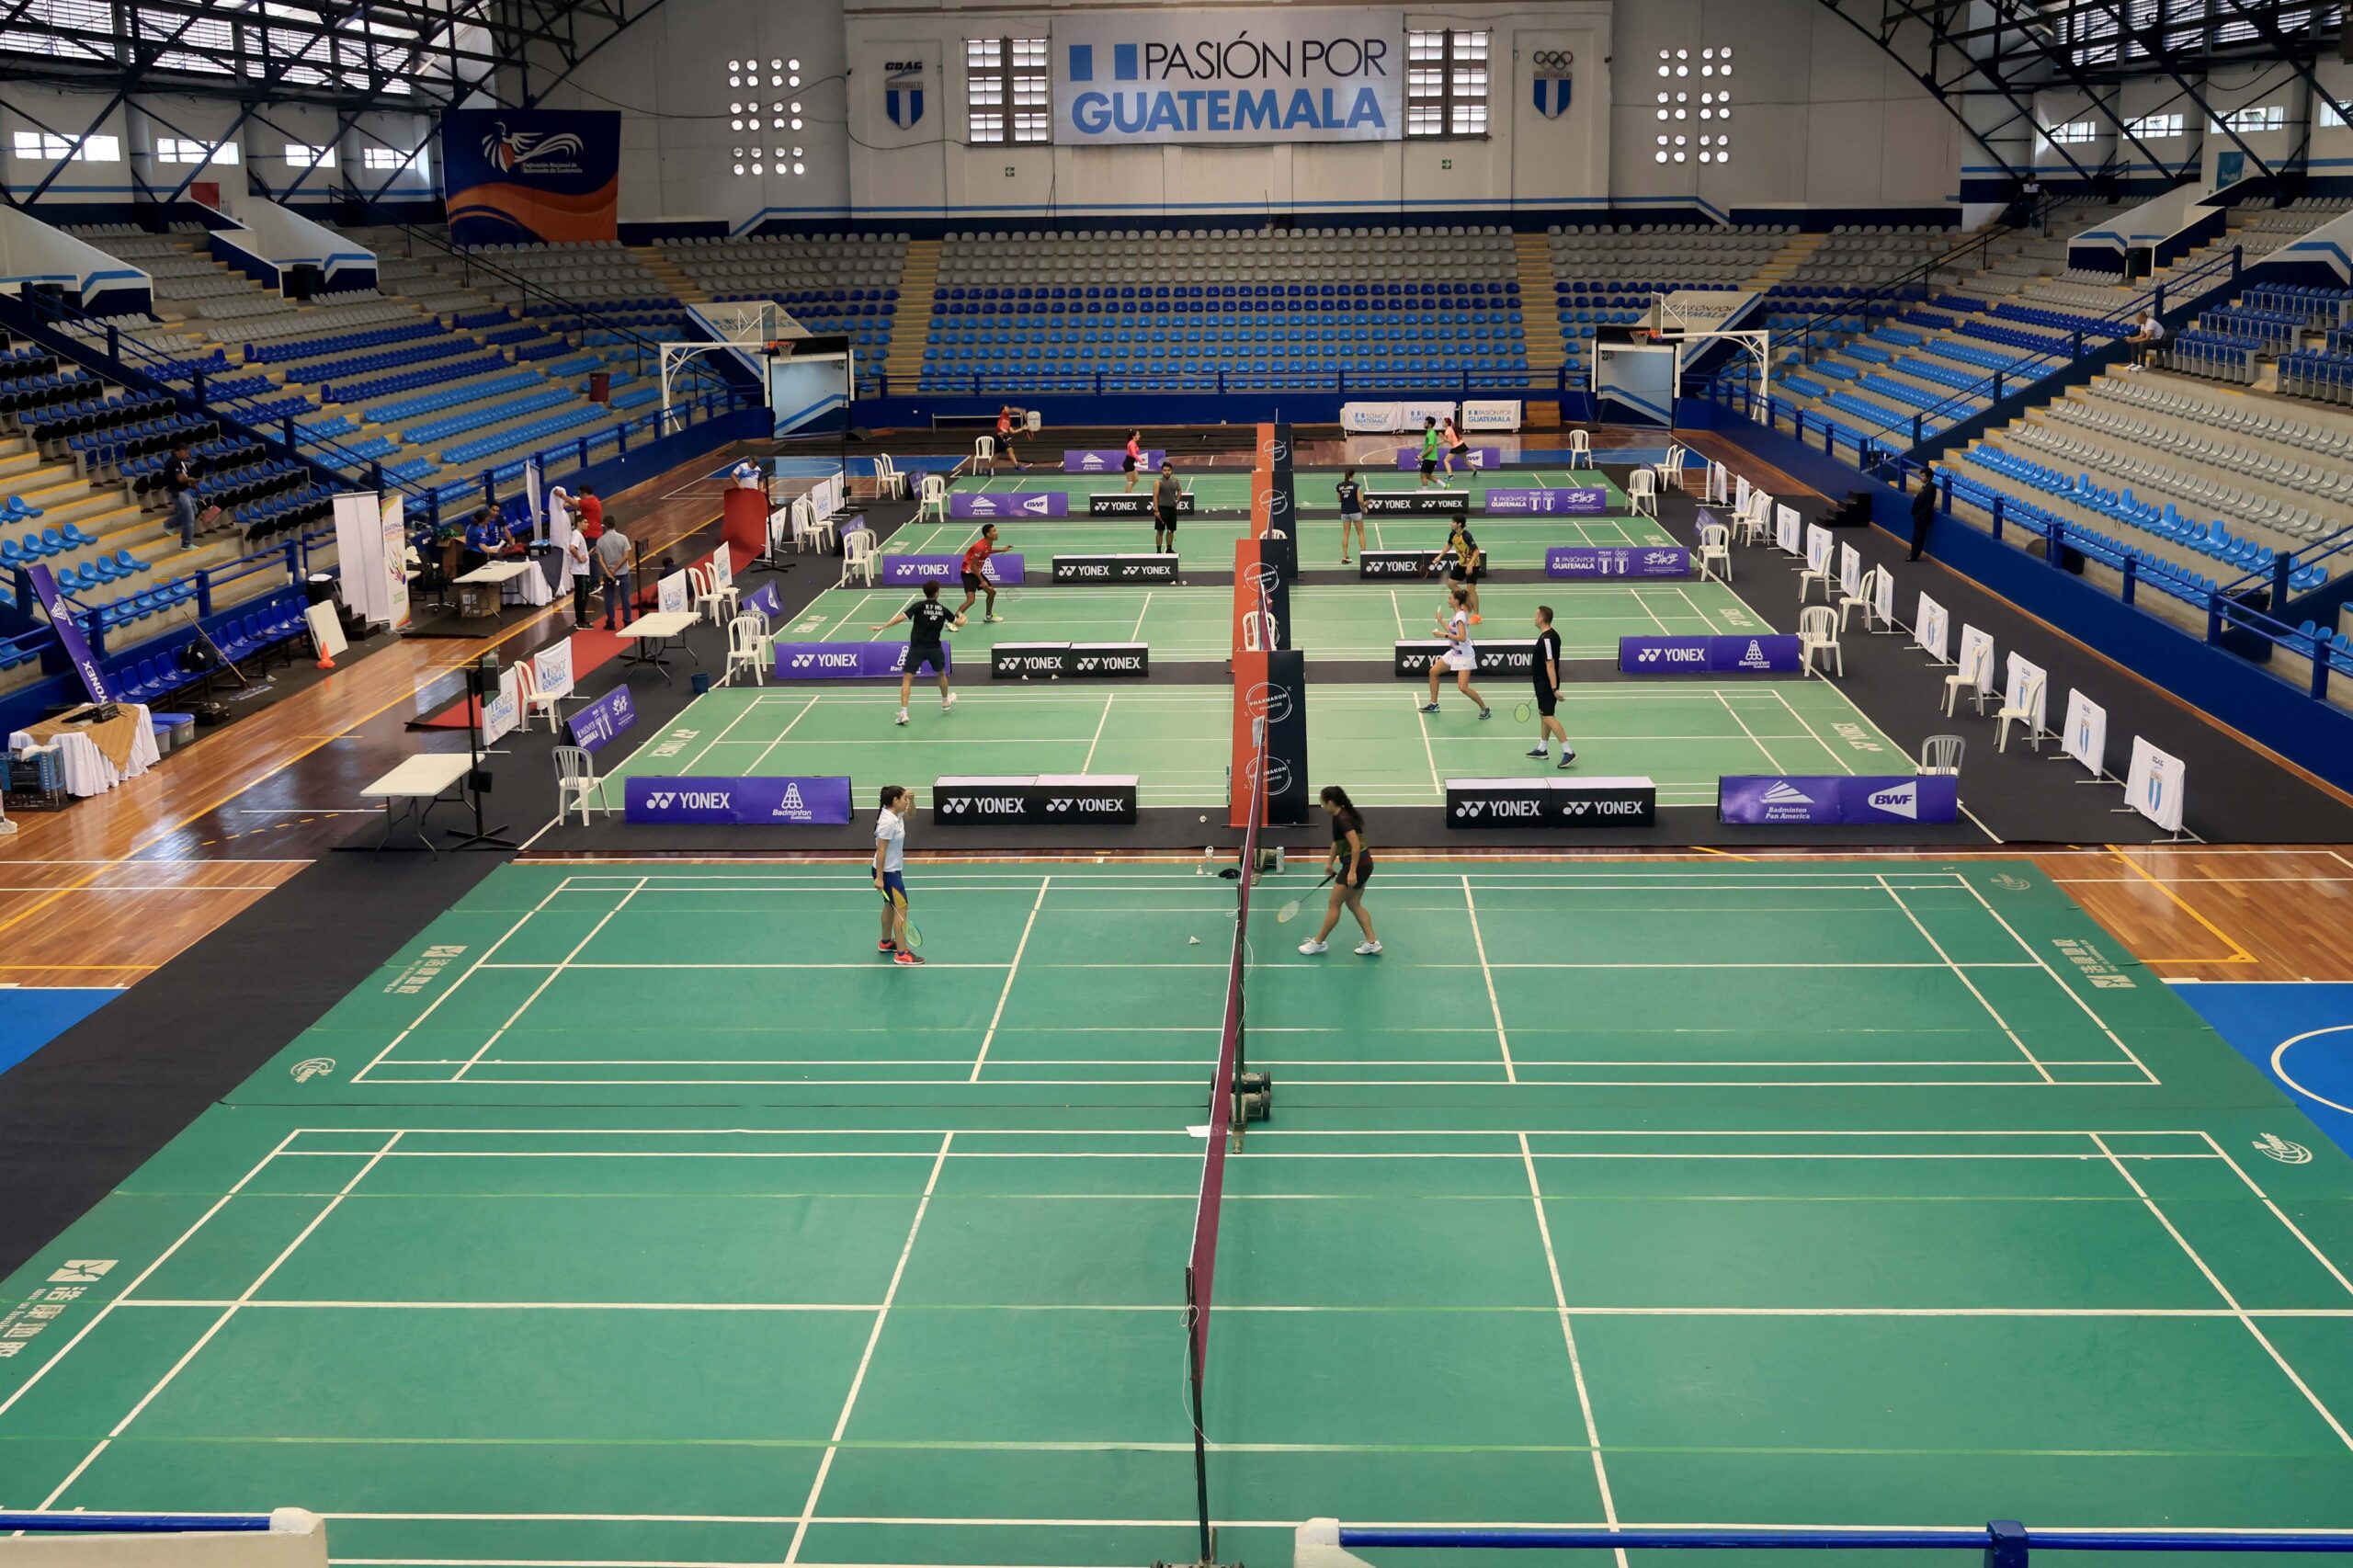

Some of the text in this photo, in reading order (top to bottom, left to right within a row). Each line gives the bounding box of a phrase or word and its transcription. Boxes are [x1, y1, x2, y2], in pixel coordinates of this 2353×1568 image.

[1145, 30, 1387, 80] PASIÓN POR
[1072, 87, 1386, 134] GUATEMALA
[1111, 502, 1137, 511] YONEX
[1384, 500, 1411, 509] YONEX
[1438, 500, 1462, 508] YONEX
[917, 564, 949, 575] YONEX
[1078, 565, 1110, 576] YONEX
[1141, 566, 1172, 575] YONEX
[1386, 561, 1417, 572] YONEX
[817, 653, 858, 666] YONEX
[1506, 653, 1532, 666] YON
[1664, 648, 1705, 661] YONEX
[1023, 656, 1063, 669] YONEX
[1101, 656, 1142, 669] YONEX
[82, 660, 108, 705] YONEX
[1249, 693, 1287, 706] PHARMAKON
[678, 792, 730, 809] YONEX
[974, 797, 1027, 813] YONEX
[1076, 799, 1125, 812] YONEX
[1874, 794, 1913, 805] BWF
[772, 809, 813, 817] Badminton
[1489, 801, 1541, 816] YONEX
[1594, 801, 1643, 815] YONEX
